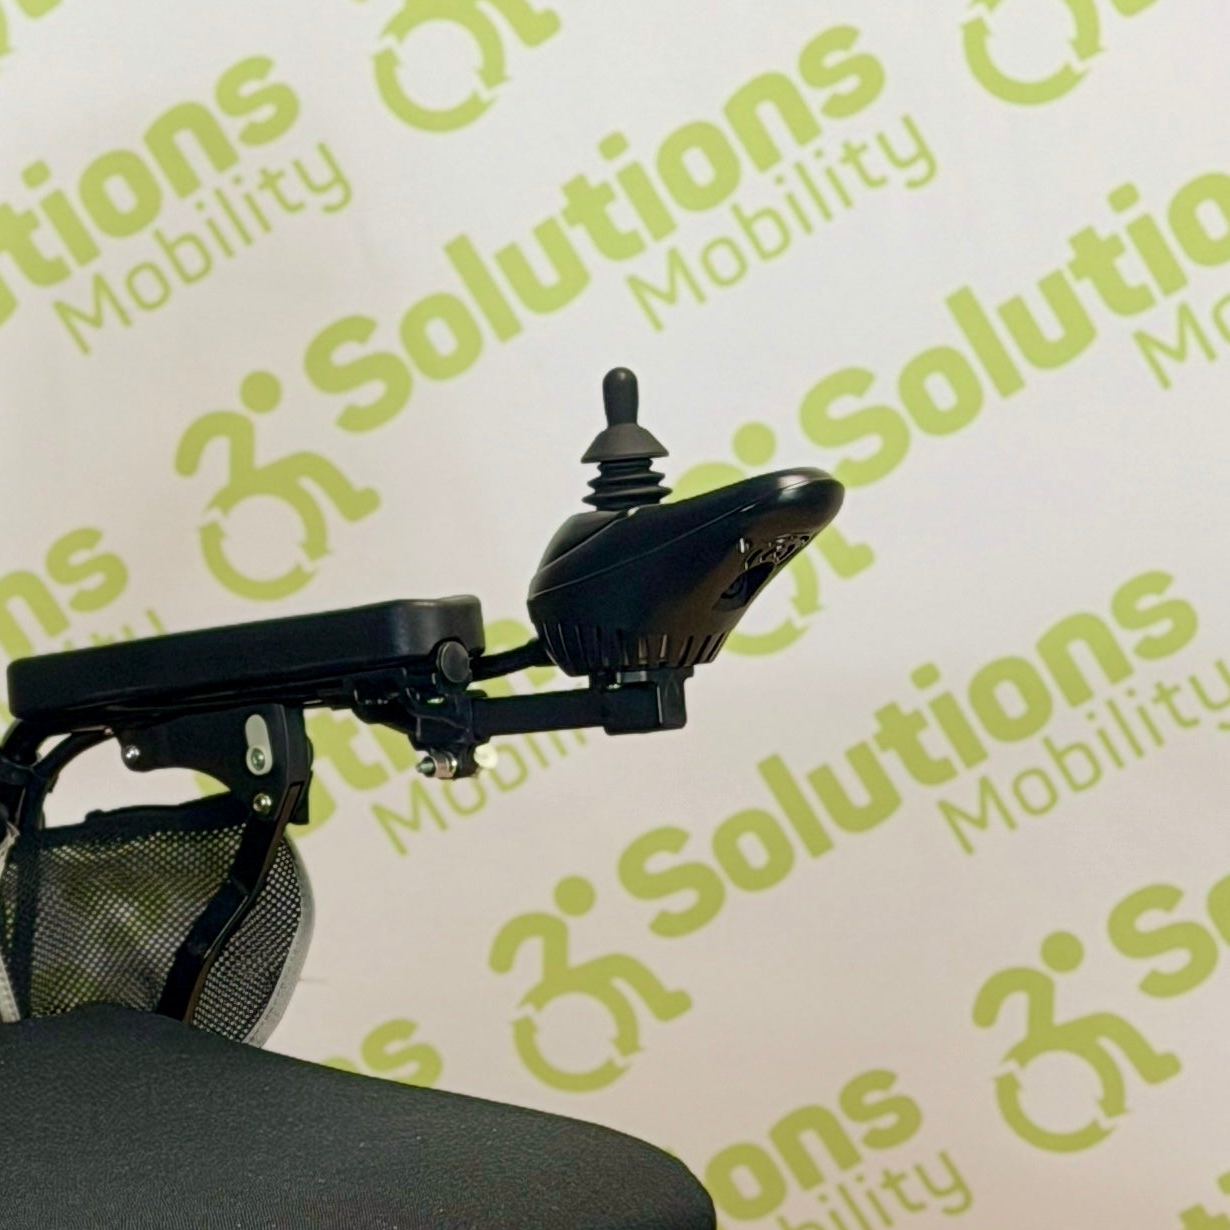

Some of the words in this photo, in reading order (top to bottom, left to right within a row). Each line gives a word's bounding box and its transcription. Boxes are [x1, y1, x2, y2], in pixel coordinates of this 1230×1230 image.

[53, 143, 352, 354] Mobility
[304, 25, 886, 433] Solutions
[626, 115, 937, 332] Mobility
[616, 571, 1198, 938] Solutions
